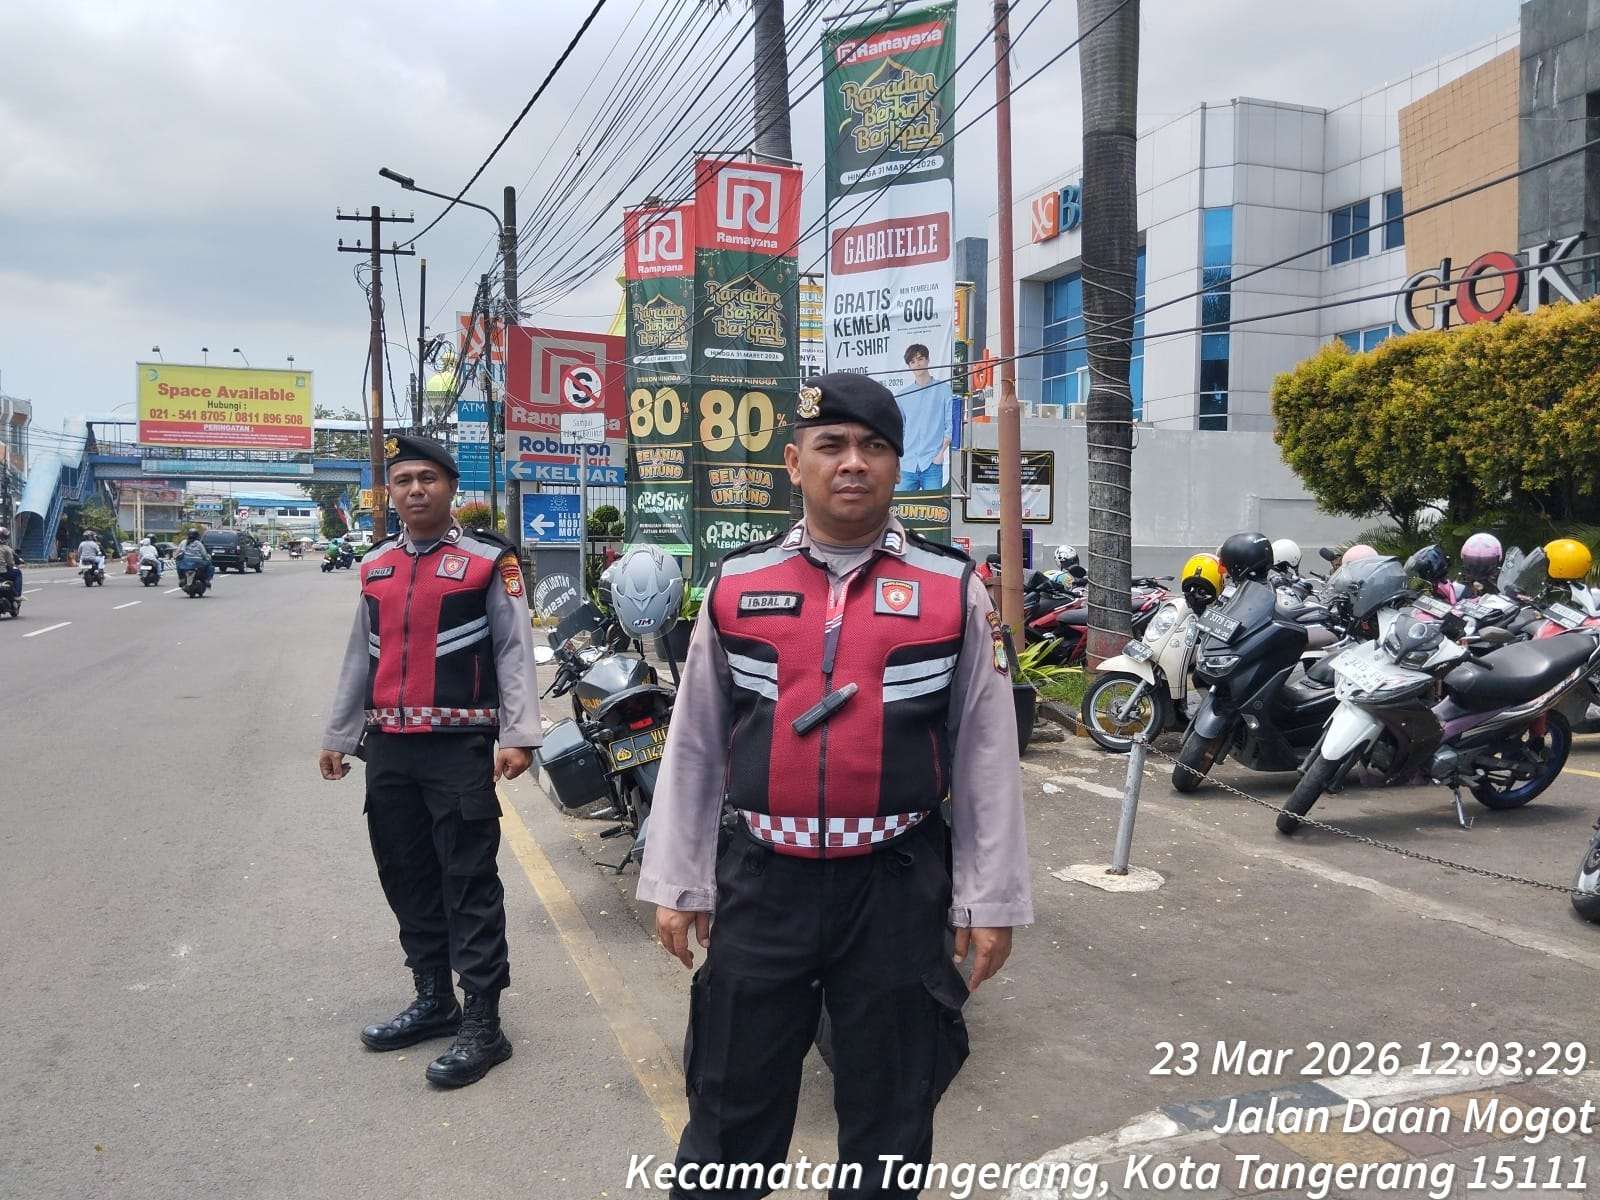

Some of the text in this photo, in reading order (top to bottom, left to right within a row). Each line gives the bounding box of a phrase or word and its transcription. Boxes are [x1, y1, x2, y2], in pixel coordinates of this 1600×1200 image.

[857, 27, 942, 58] Ramayana
[839, 71, 938, 112] Ramadan
[864, 94, 933, 127] Berkah
[852, 119, 943, 153] Berlipat
[716, 232, 778, 249] Ramayana
[844, 223, 939, 266] GABRIELLE
[638, 265, 684, 274] Ramayana
[704, 281, 783, 306] Ramadan
[834, 288, 891, 315] GRATIS
[722, 302, 781, 321] Berkah
[904, 296, 934, 323] 600
[834, 313, 890, 338] KEMEJA
[836, 336, 890, 358] /T-SHIRT
[158, 383, 296, 401] Space Available
[150, 408, 168, 419] 021
[178, 410, 198, 420] 541
[201, 411, 226, 421] 8705
[235, 412, 260, 422] 0811
[263, 413, 282, 424] 896
[285, 414, 303, 424] 508
[207, 401, 242, 411] Hubungi
[461, 403, 485, 413] ATM
[536, 465, 619, 483] KELUAR
[709, 468, 773, 489] BELANJA
[711, 487, 771, 507] UNTUNG
[559, 519, 581, 528] MOBI
[559, 528, 581, 537] MOTO
